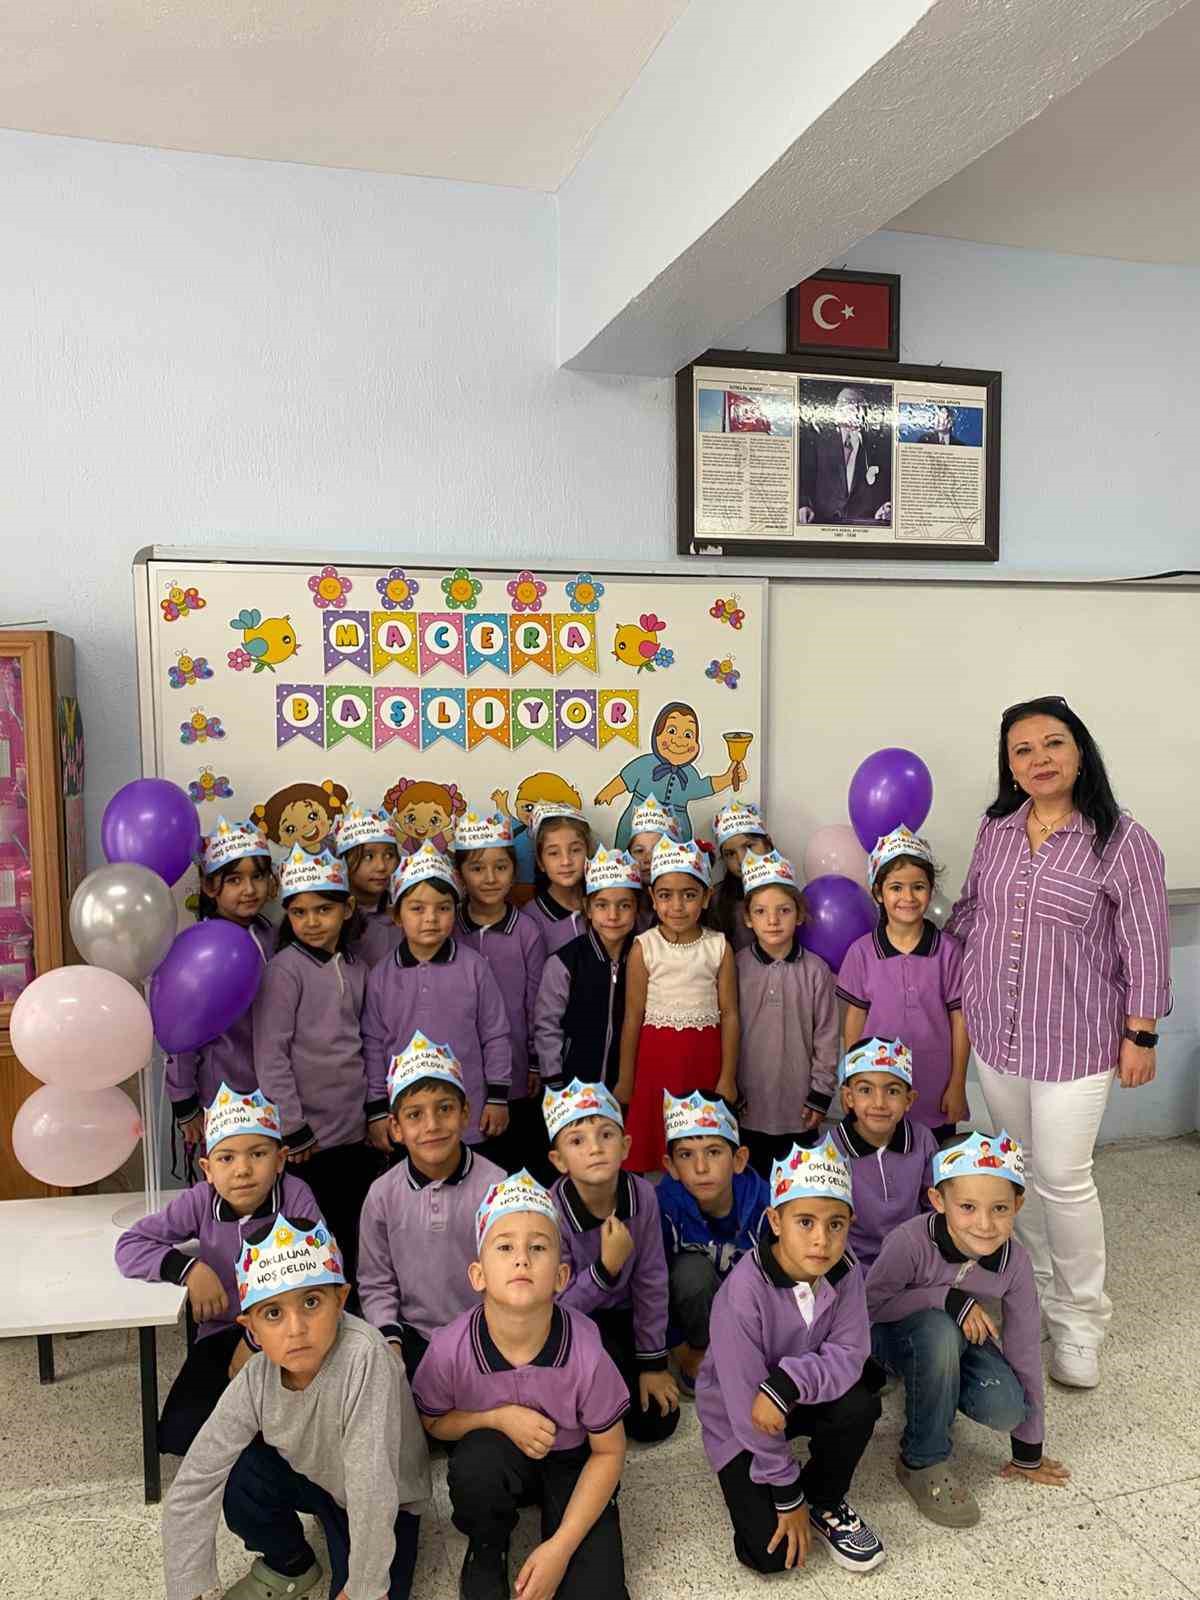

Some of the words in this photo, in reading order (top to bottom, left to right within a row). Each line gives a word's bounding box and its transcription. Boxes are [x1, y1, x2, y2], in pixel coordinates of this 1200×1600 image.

[335, 624, 586, 649] MACERA
[292, 699, 628, 727] BAŞLIYOR
[258, 1248, 311, 1269] OKULUNA
[256, 1270, 278, 1284] HOŞ
[280, 1261, 318, 1276] GELDİN
